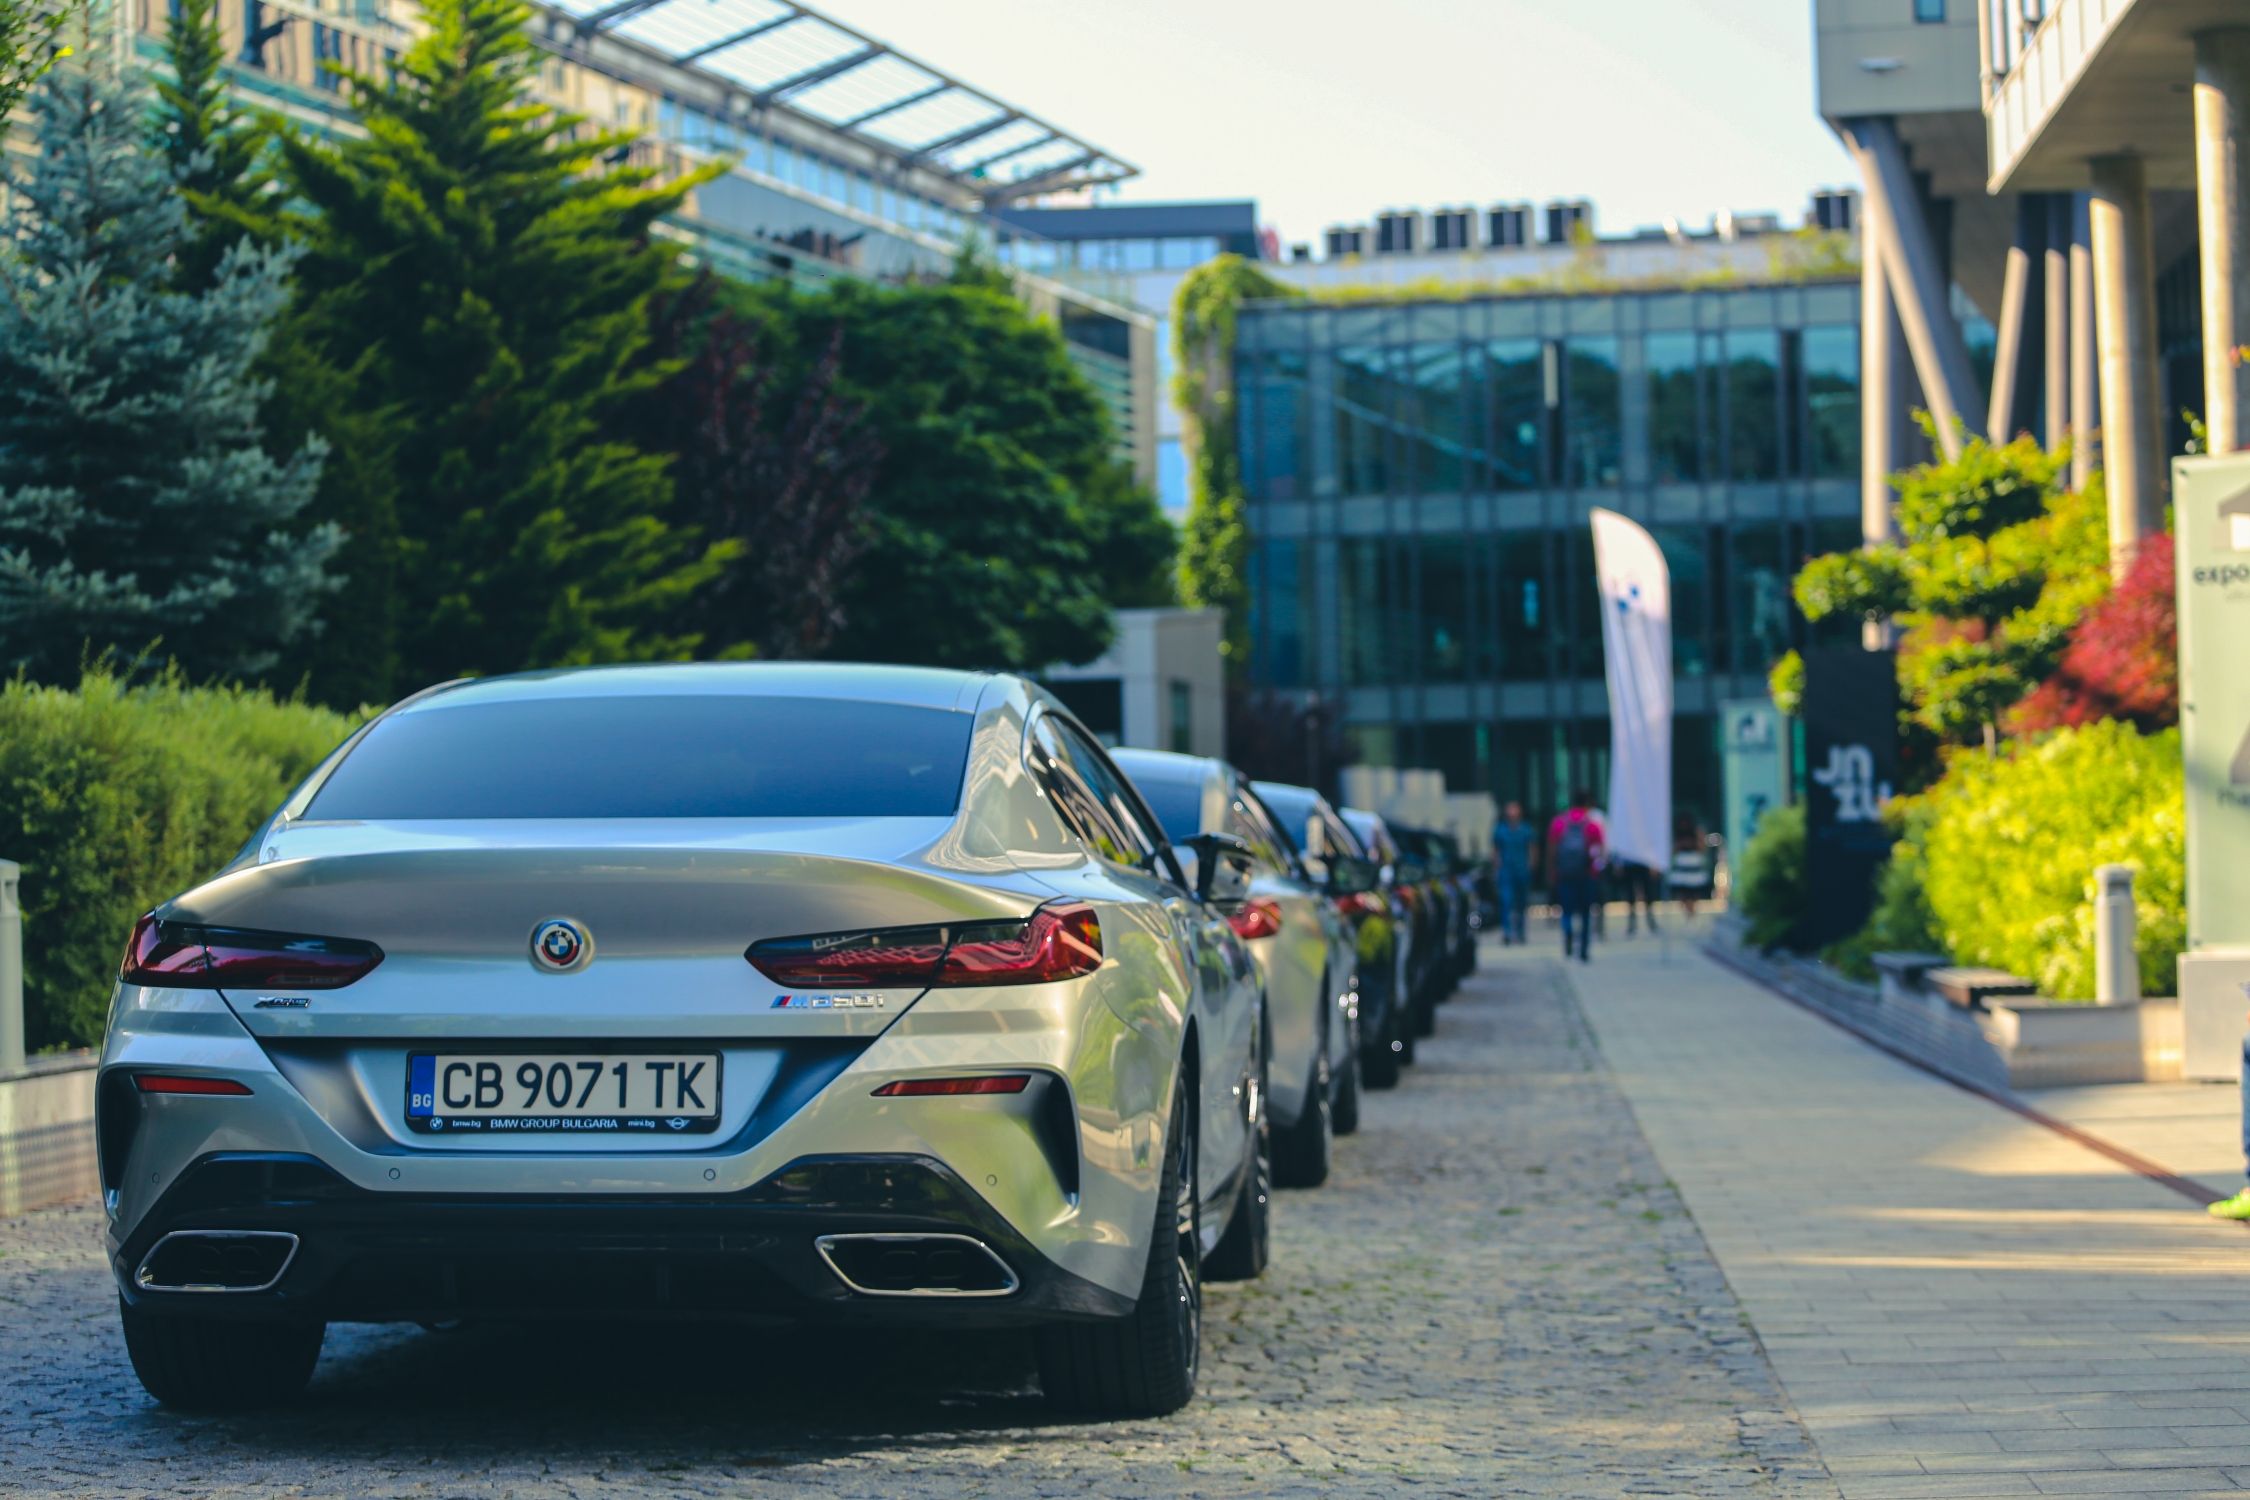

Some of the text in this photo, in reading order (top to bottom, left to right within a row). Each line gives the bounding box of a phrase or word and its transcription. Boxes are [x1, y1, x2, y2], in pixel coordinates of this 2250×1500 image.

[443, 1062, 706, 1109] CB 9071 TK
[412, 1094, 432, 1108] BG
[452, 1119, 655, 1129] bmw.bg BMW GROUP BULGARIA mini.bg
